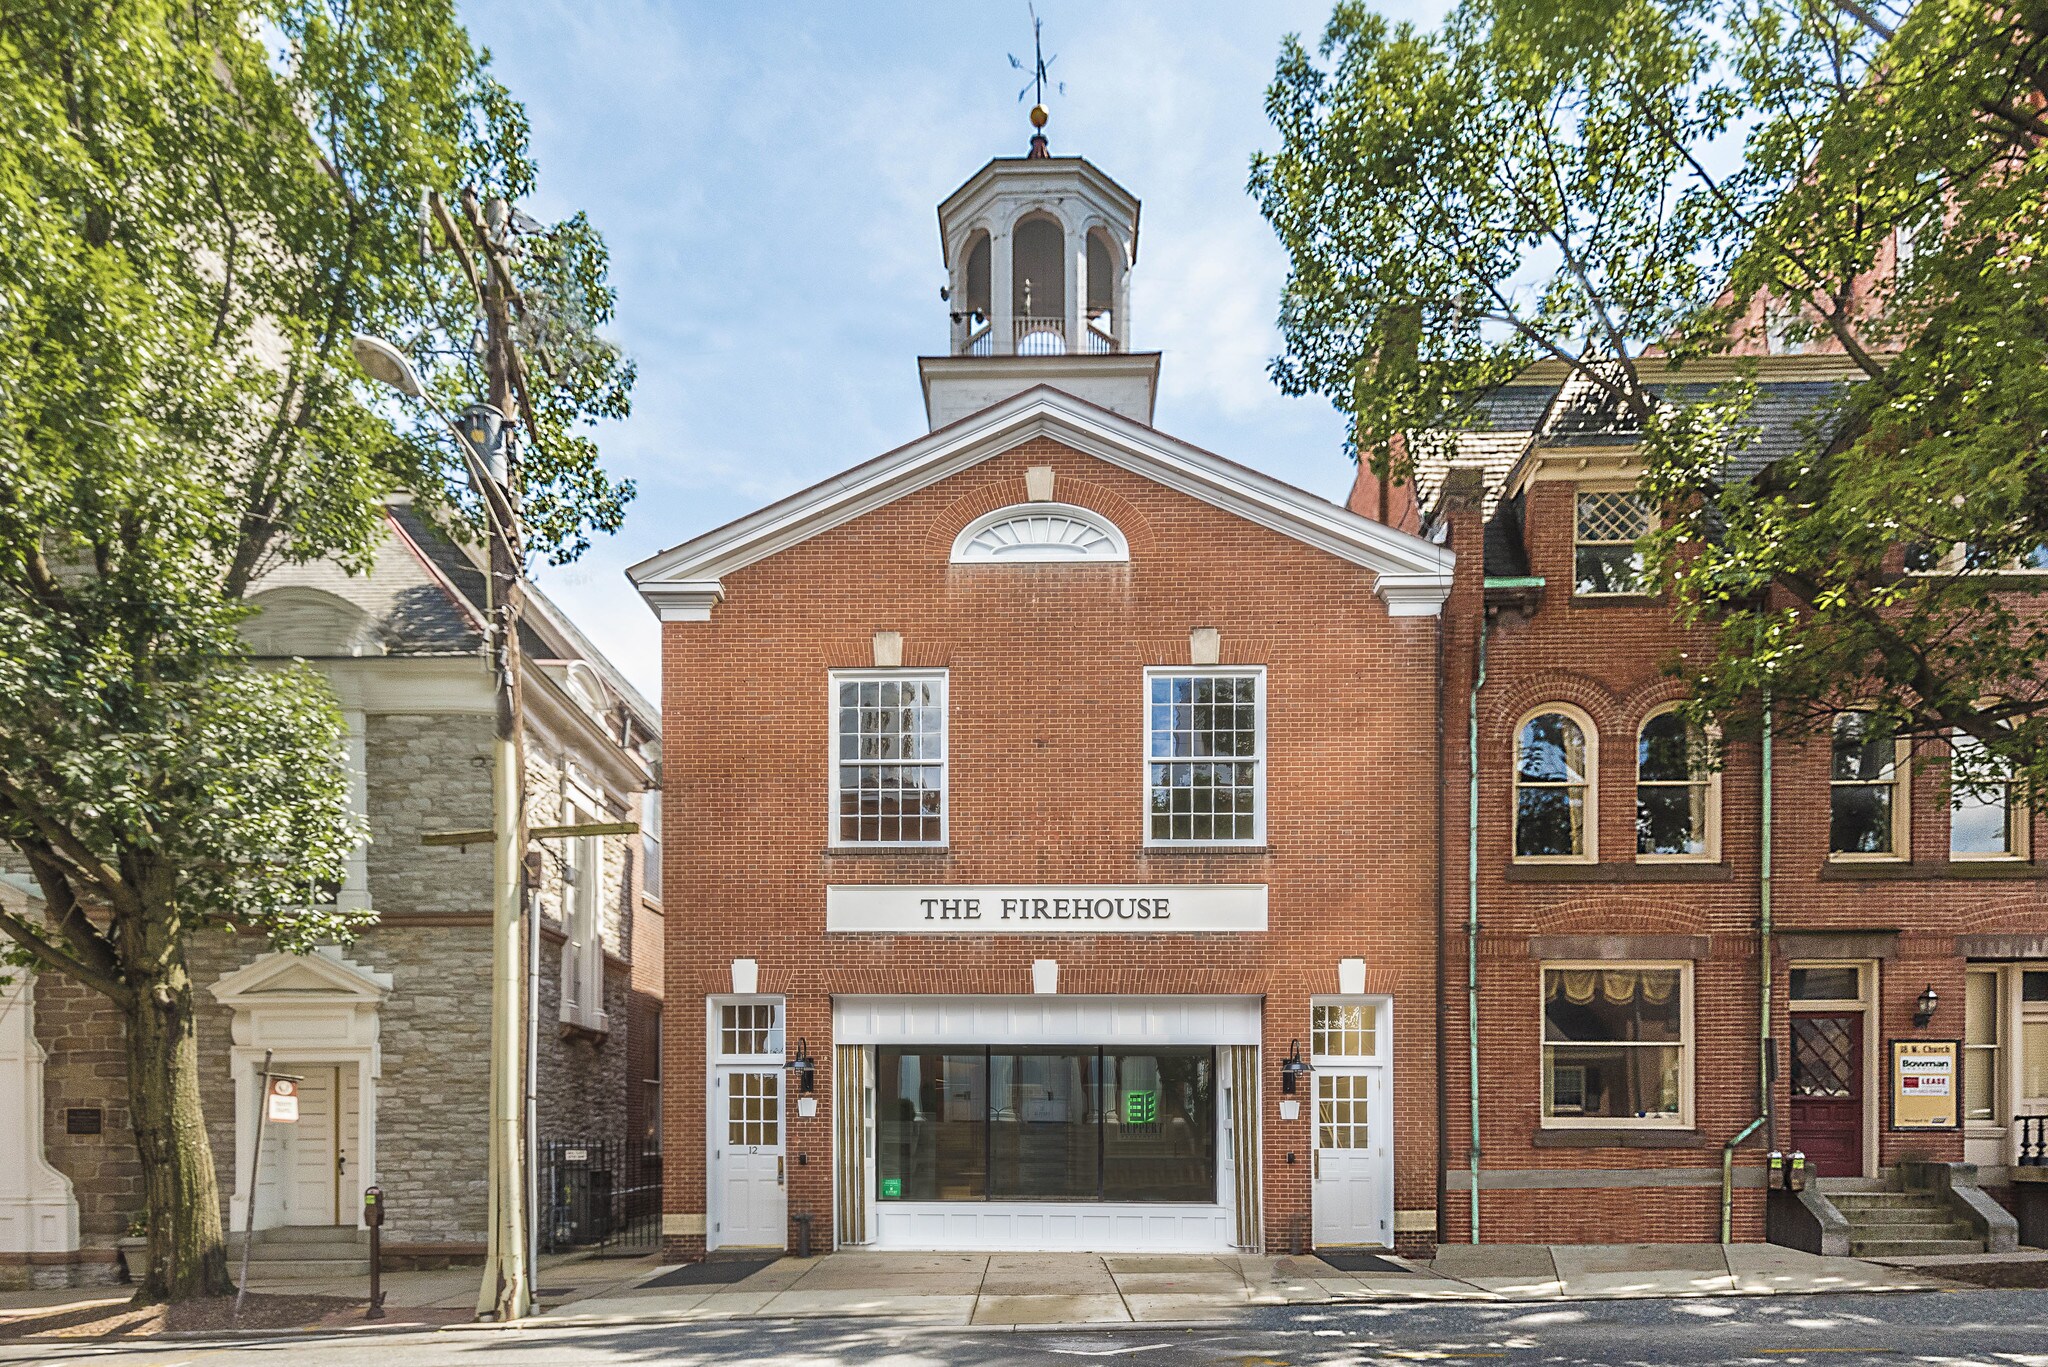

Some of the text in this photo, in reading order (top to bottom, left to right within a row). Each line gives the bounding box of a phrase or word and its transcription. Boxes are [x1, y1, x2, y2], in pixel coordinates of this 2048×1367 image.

[920, 898, 1171, 920] THE FIREHOUSE
[1922, 1045, 1951, 1053] Church
[1902, 1059, 1949, 1068] Bowman
[1120, 1122, 1162, 1134] RUPPERT
[748, 1146, 758, 1155] 12
